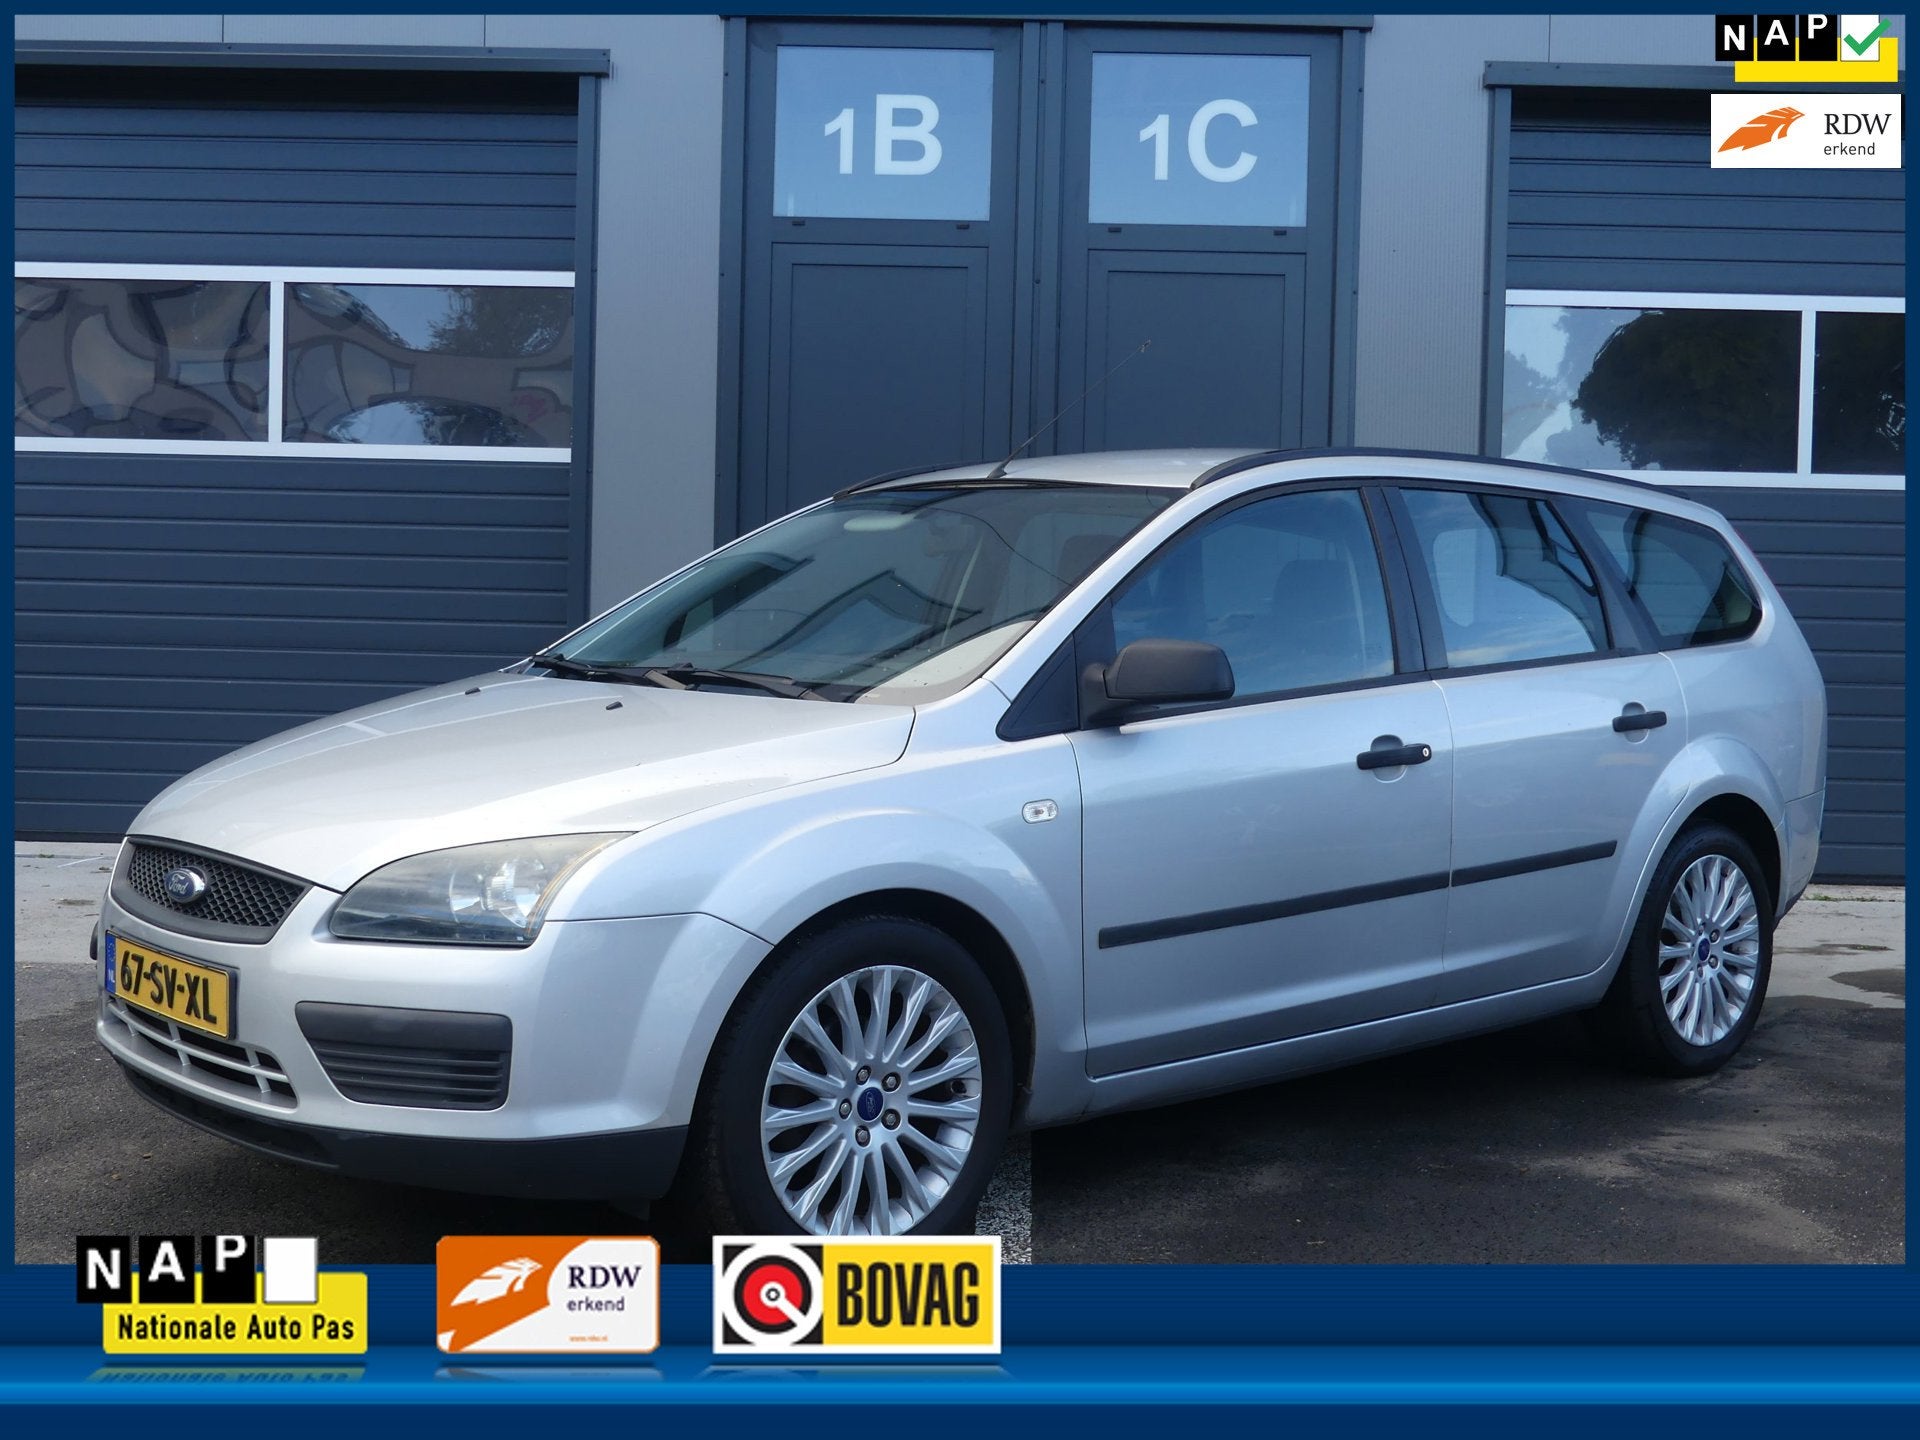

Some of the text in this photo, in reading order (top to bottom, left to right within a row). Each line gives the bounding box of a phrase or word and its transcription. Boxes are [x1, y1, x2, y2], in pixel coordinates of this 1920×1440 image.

[824, 94, 943, 176] 1B
[1138, 98, 1259, 183] 1C
[168, 873, 190, 895] Ford
[120, 950, 218, 1025] 67-SV-XL
